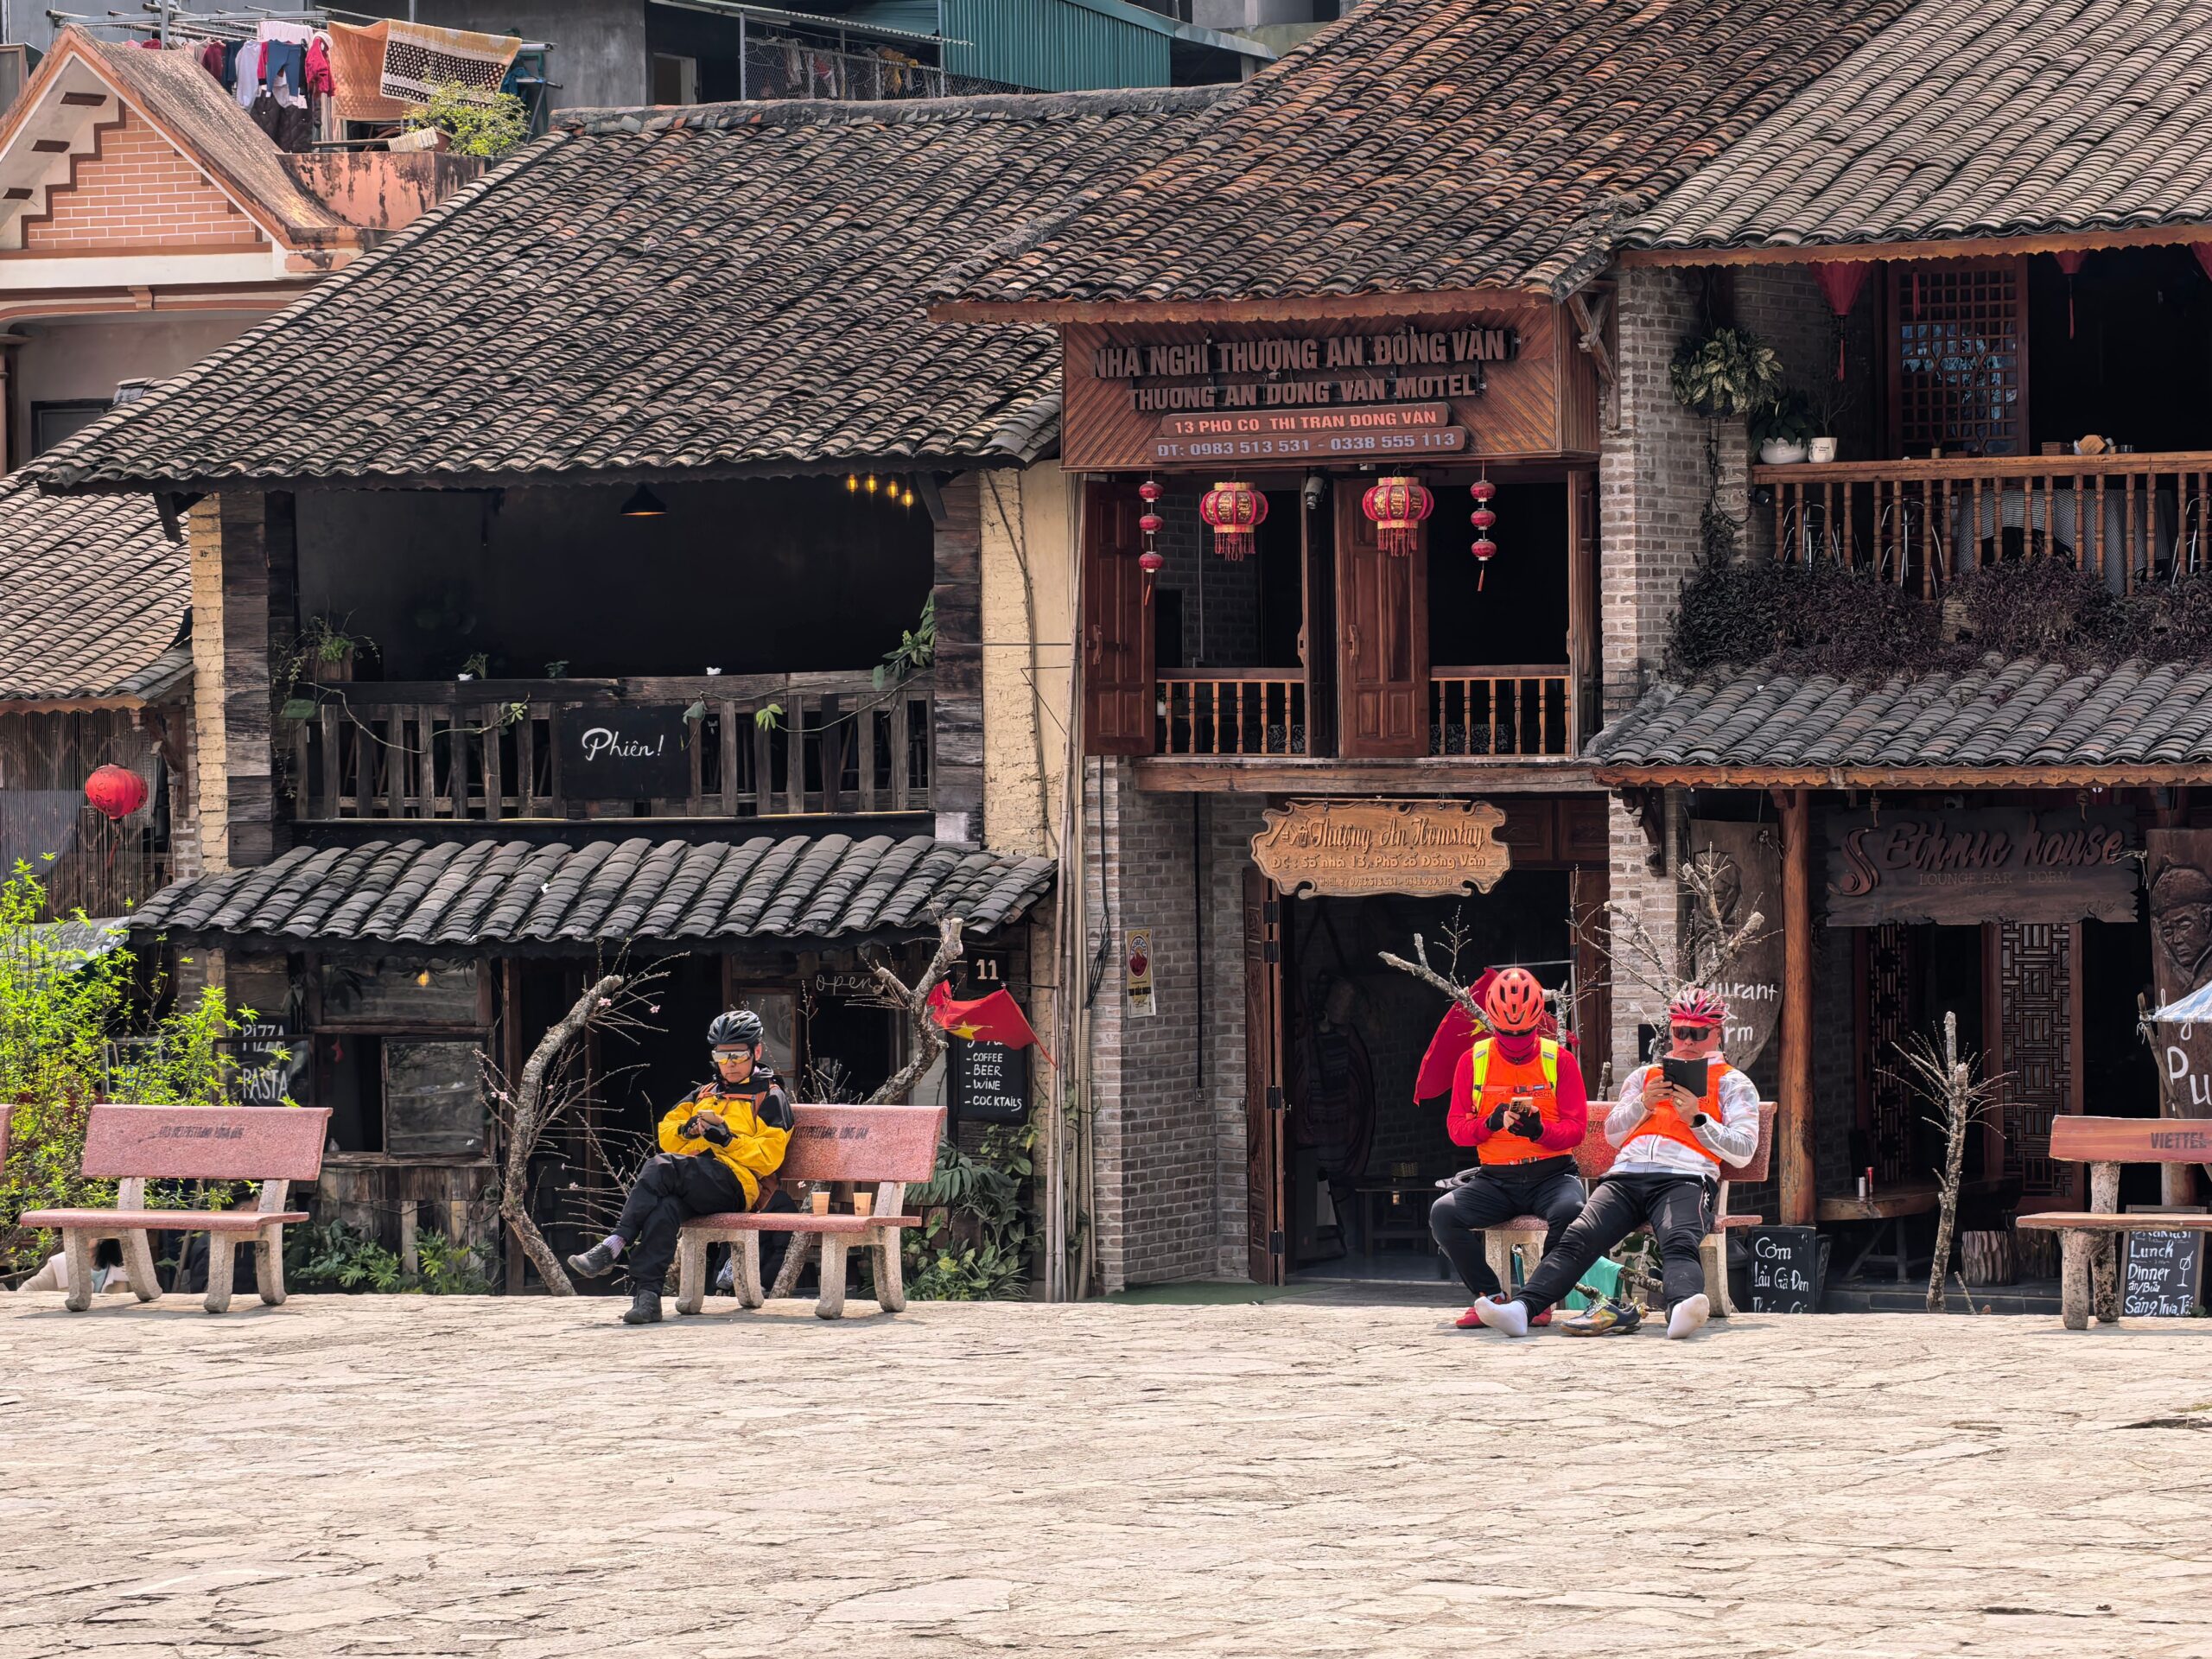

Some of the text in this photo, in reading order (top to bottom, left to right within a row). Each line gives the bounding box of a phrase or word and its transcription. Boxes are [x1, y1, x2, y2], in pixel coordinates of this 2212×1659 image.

[1326, 335, 1363, 367] AN
[1224, 383, 1257, 407] AN
[1175, 422, 1194, 434] 13
[1269, 416, 1295, 430] THI
[1190, 442, 1234, 455] 0983
[1240, 441, 1273, 454] 513
[1278, 439, 1310, 453] 531
[1330, 436, 1376, 451] 0338
[1382, 435, 1415, 448] 555
[1421, 432, 1455, 448] 113
[582, 727, 664, 761] Phiên!
[1379, 817, 1408, 847] An
[1918, 870, 2073, 887] LOUNGE BAR DORM
[976, 958, 999, 981] 11
[972, 1052, 1003, 1063] COFFEE
[973, 1064, 1003, 1077] BEER
[242, 1067, 289, 1100] PASTA
[2151, 1132, 2207, 1149] VIETTEL
[1755, 1236, 1792, 1261] Cơm
[2129, 1239, 2175, 1259] Lunch
[2127, 1262, 2171, 1281] Dinner
